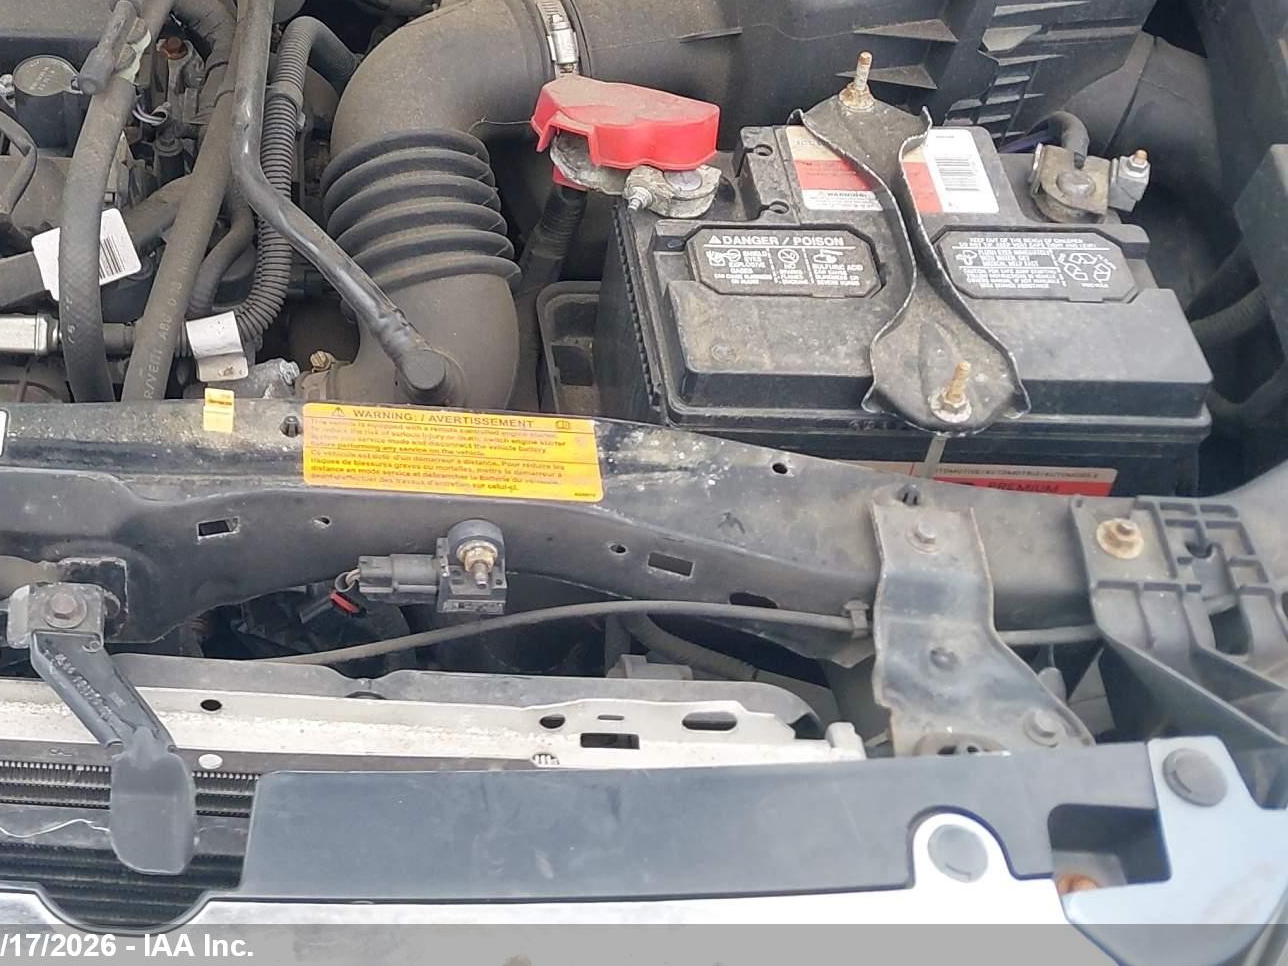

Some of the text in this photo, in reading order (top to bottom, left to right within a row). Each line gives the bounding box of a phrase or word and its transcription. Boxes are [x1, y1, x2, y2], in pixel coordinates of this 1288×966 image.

[722, 236, 779, 246] DANGER
[793, 237, 845, 246] POISON
[352, 409, 418, 421] WARNING:
[429, 414, 534, 429] AVERTISSEMENT
[337, 443, 380, 452] performing
